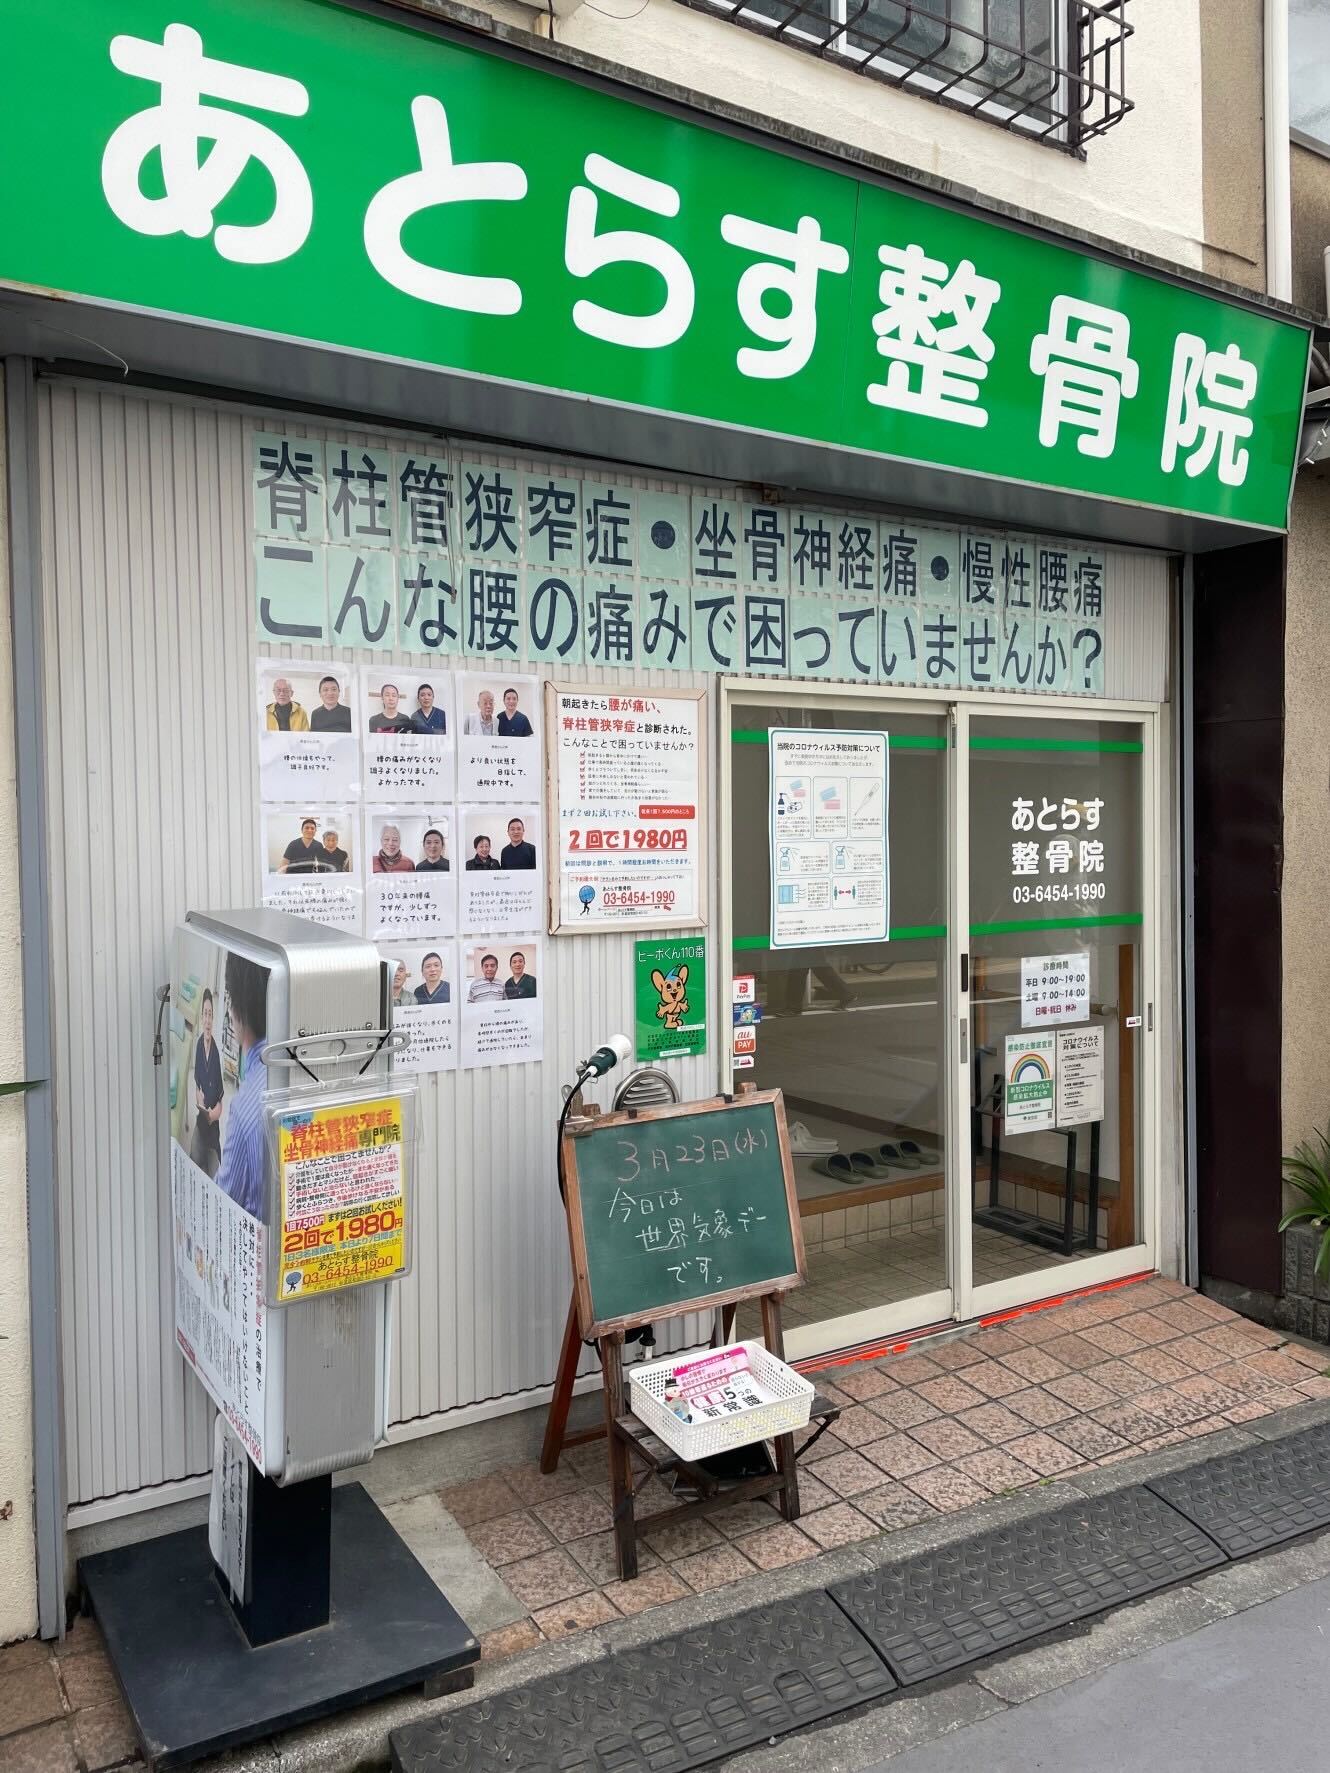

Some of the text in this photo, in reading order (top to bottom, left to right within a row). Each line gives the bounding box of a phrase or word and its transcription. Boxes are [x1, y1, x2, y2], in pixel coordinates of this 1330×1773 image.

[101, 23, 1259, 487] あとらす整骨院
[1011, 797, 1105, 832] あとらす
[1011, 840, 1105, 875] 整骨院
[603, 890, 676, 905] 03-6454-1990
[1012, 883, 1106, 903] 03-6454-1990
[737, 1041, 752, 1049] PAY
[608, 1187, 683, 1223] 今日は
[635, 1206, 767, 1252] 世界気象デー
[667, 1256, 723, 1284] です。
